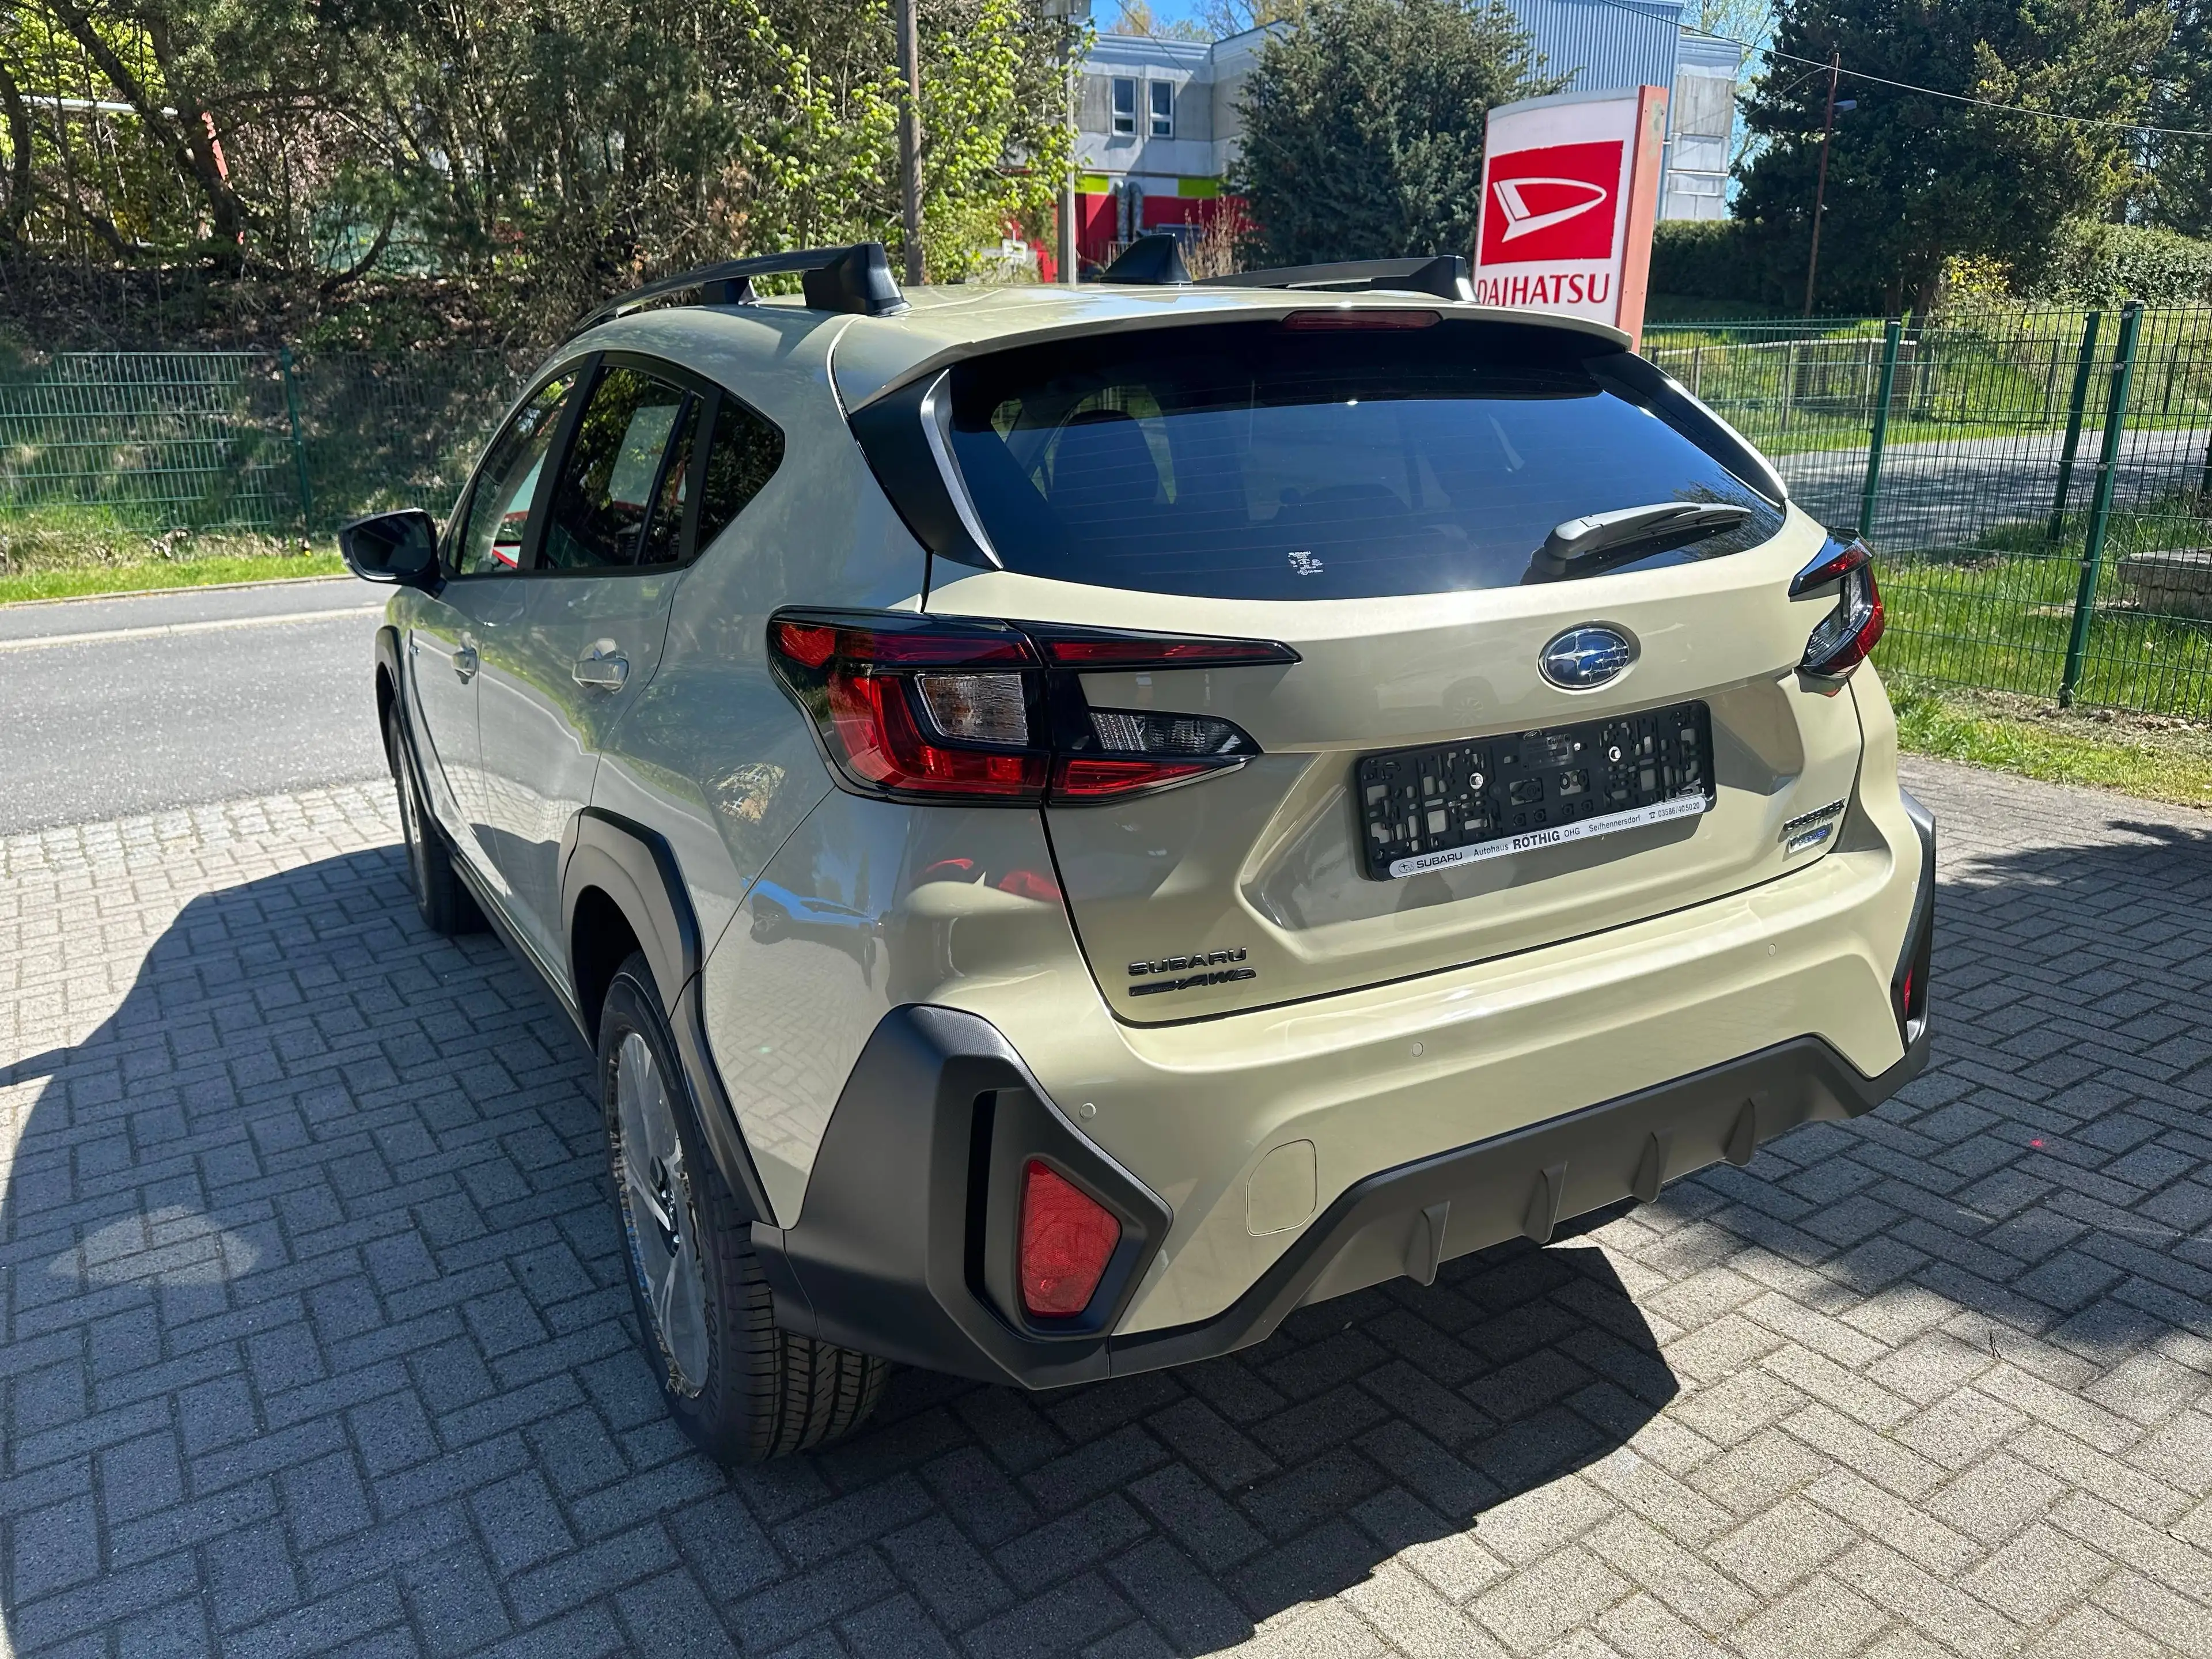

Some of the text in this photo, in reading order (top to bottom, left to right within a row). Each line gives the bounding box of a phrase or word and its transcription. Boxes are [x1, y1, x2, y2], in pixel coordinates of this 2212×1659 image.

[1477, 273, 1610, 306] DAIHATSU
[1416, 851, 1463, 869] SUBARU
[1474, 843, 1509, 857] Autohaus
[1513, 830, 1560, 850] RÖTHIG
[1564, 827, 1580, 838] OHG
[1589, 814, 1641, 832] Seifhennersdorf
[1128, 946, 1247, 976] SUBARU
[1177, 967, 1257, 990] AWD
